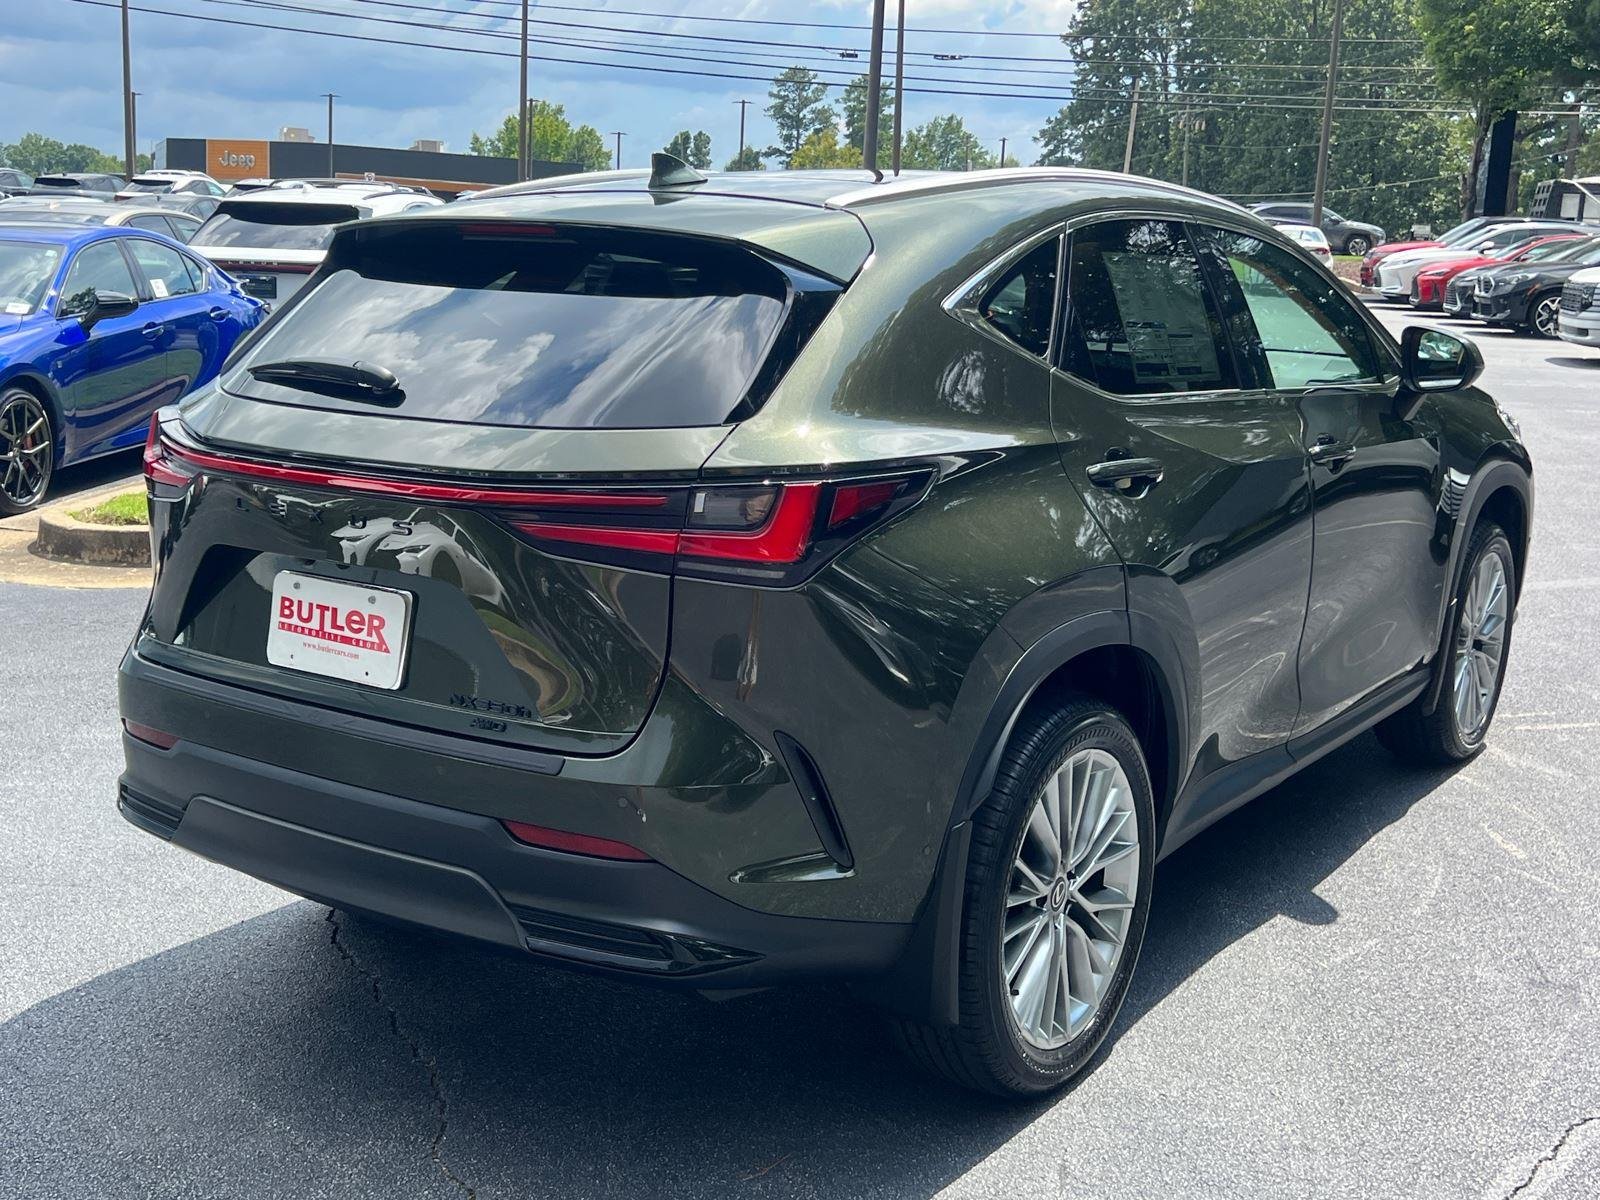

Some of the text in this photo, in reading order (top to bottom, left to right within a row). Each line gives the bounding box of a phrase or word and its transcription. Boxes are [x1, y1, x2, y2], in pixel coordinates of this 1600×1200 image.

[218, 150, 255, 170] Jeep
[235, 497, 413, 536] LEXUS
[303, 641, 360, 659] www.butlercars.com
[351, 638, 387, 653] GROUP
[471, 718, 507, 733] AWD
